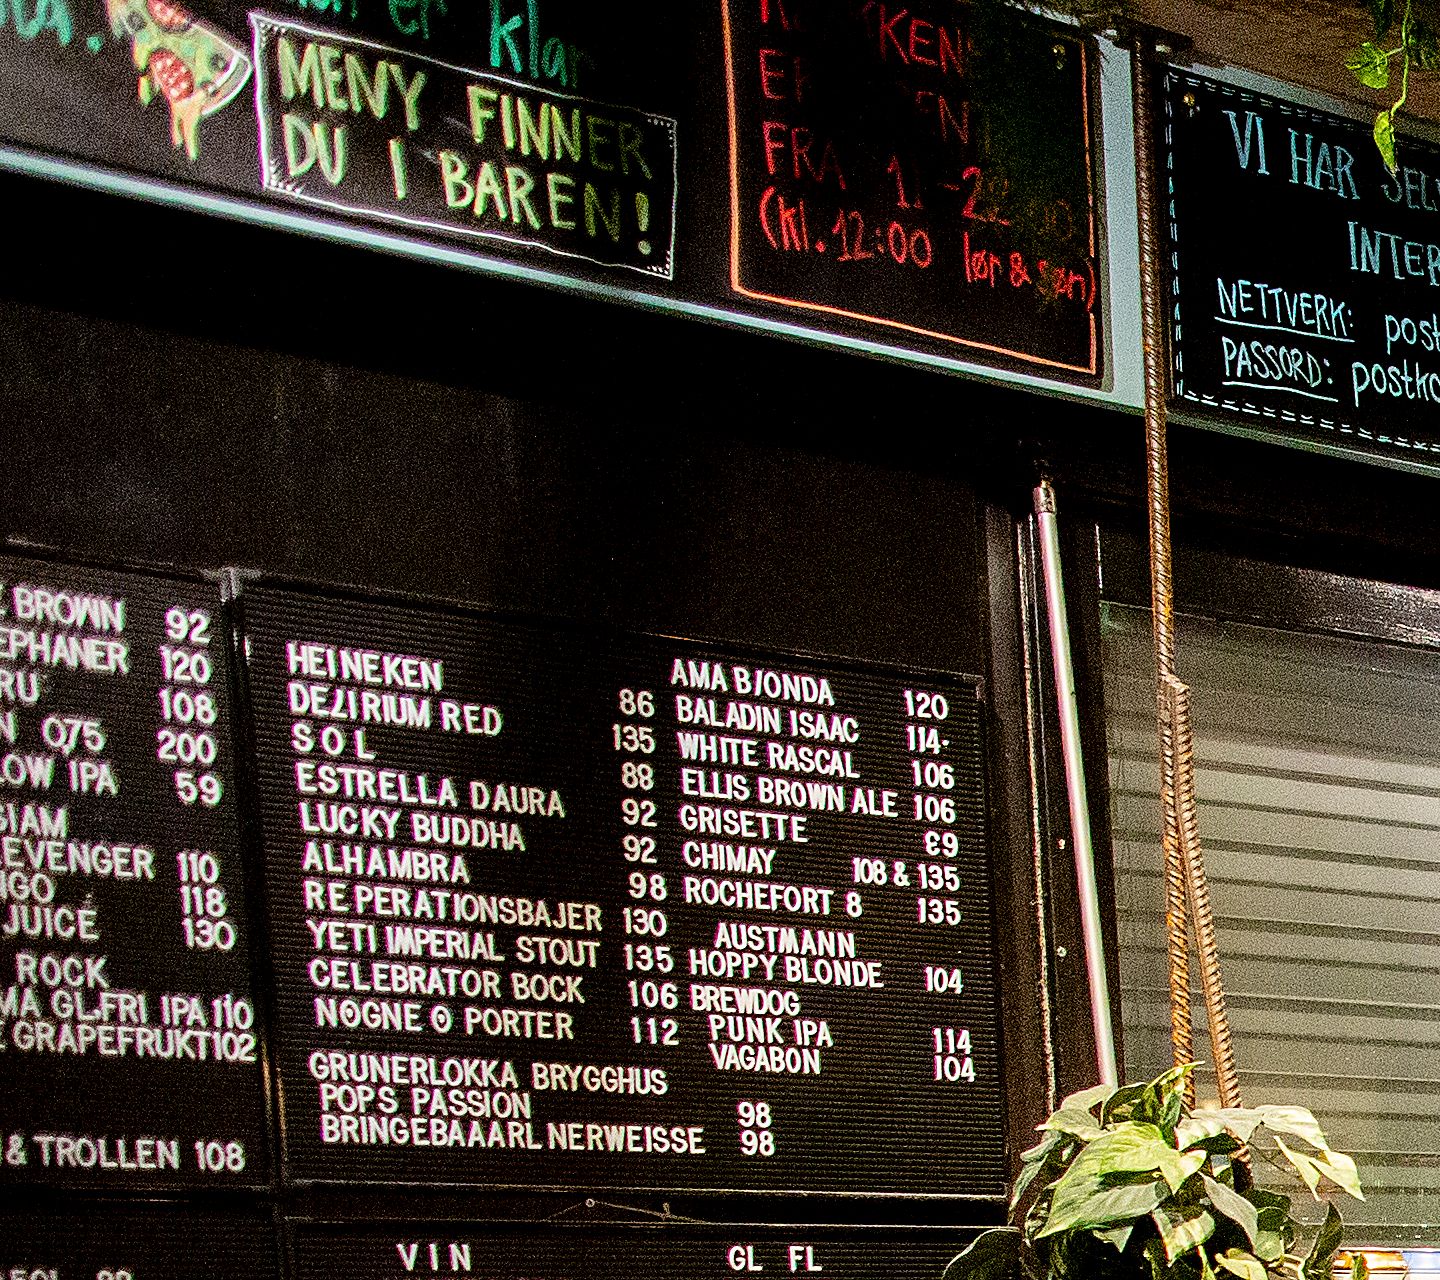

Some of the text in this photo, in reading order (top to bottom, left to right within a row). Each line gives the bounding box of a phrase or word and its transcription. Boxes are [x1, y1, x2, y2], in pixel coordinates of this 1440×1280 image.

[278, 38, 653, 179] MENY FINNER
[1222, 110, 1270, 176] VI
[1288, 128, 1361, 200] HAR
[282, 112, 652, 255] DU I BAREN!
[832, 207, 933, 269] 12:00
[1217, 277, 1354, 336] NETTVERK:
[1222, 336, 1333, 388] PASSORD:
[14, 584, 124, 632] BROWN
[287, 641, 442, 698] HEINEKEN
[671, 659, 728, 691] AMA
[441, 701, 502, 735] RED
[676, 695, 859, 742] BALADIN ISAAC
[69, 759, 118, 795] IPA
[677, 732, 954, 789] WHITE RASCAL 106
[296, 761, 565, 817] ESTRELLA DAURA
[682, 768, 898, 817] ELLIS BROWN ALE
[299, 802, 525, 851] LUCKY BUDDHA
[680, 805, 808, 842] GRISETTE
[303, 841, 469, 883] ALHAMBRA
[683, 841, 960, 891] CHIMAY 135
[685, 877, 834, 915] ROCHEFORT
[3, 904, 99, 940] JUICE
[715, 923, 855, 958] AUSTMANN
[306, 920, 600, 967] YETI IMPERIAL STOUT
[16, 953, 109, 989] ROCK
[309, 959, 585, 1003] CELEBRATOR BOCK
[689, 949, 963, 994] HOPPY BLONDE 104
[161, 996, 207, 1028] IPA
[691, 984, 800, 1016] BREWDOG
[13, 1023, 210, 1062] GRAPEFRUKT
[465, 1007, 573, 1039] PORTER
[709, 1015, 833, 1047] PUNK IPA
[532, 1063, 668, 1095] BRYGGHUS
[709, 1043, 976, 1082] VAGABON 104
[320, 1083, 530, 1118] POPS PASSION
[33, 1135, 179, 1169] TROLLEN
[728, 1246, 822, 1272] GL FL
